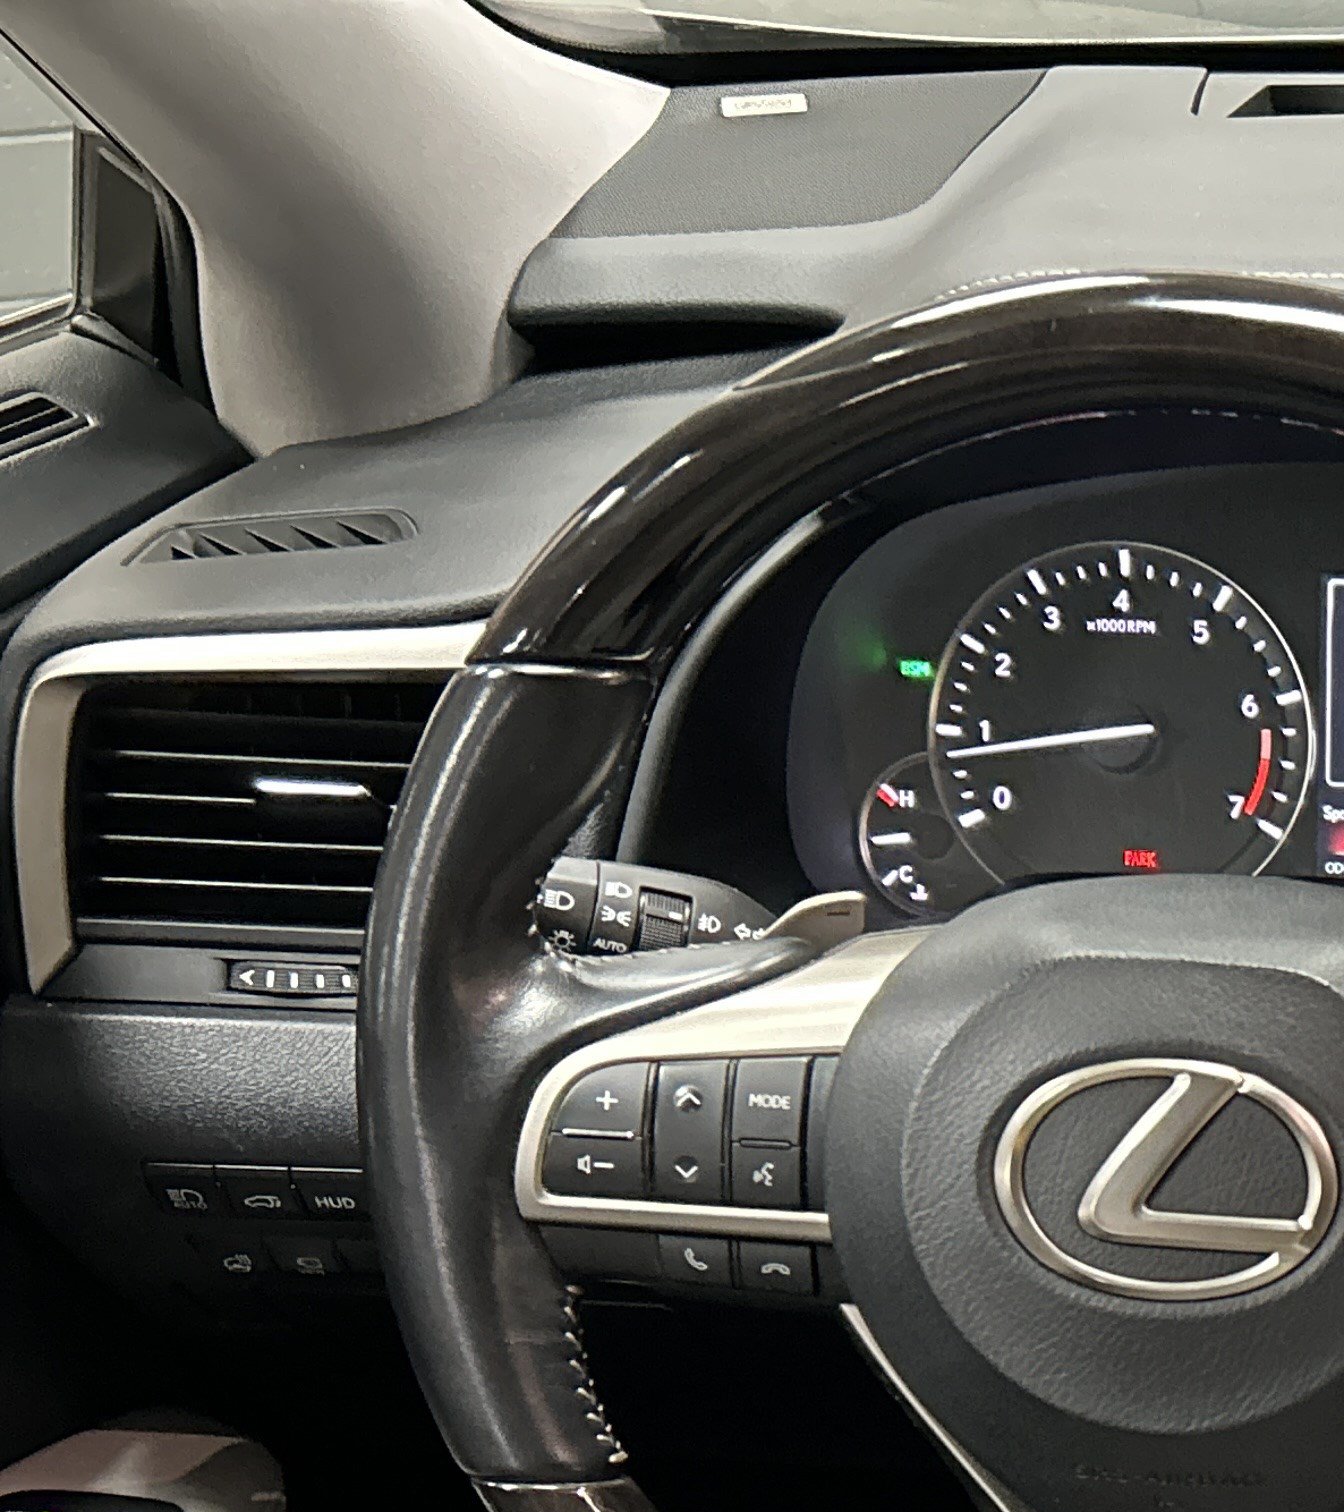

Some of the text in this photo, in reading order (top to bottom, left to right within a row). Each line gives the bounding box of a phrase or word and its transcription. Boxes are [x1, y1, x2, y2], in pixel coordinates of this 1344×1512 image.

[1112, 589, 1131, 611] 4
[1043, 606, 1062, 631] 3
[1191, 620, 1210, 645] 5
[994, 652, 1013, 678] 2
[1240, 693, 1260, 718] 6
[977, 720, 992, 741] 1
[899, 789, 915, 808] H
[992, 786, 1012, 810] 0
[1227, 793, 1246, 819] 7
[1123, 850, 1159, 869] PARK
[899, 866, 915, 885] C
[592, 936, 629, 954] AUTO
[748, 1093, 792, 1111] MODE
[313, 1195, 356, 1211] HUD
